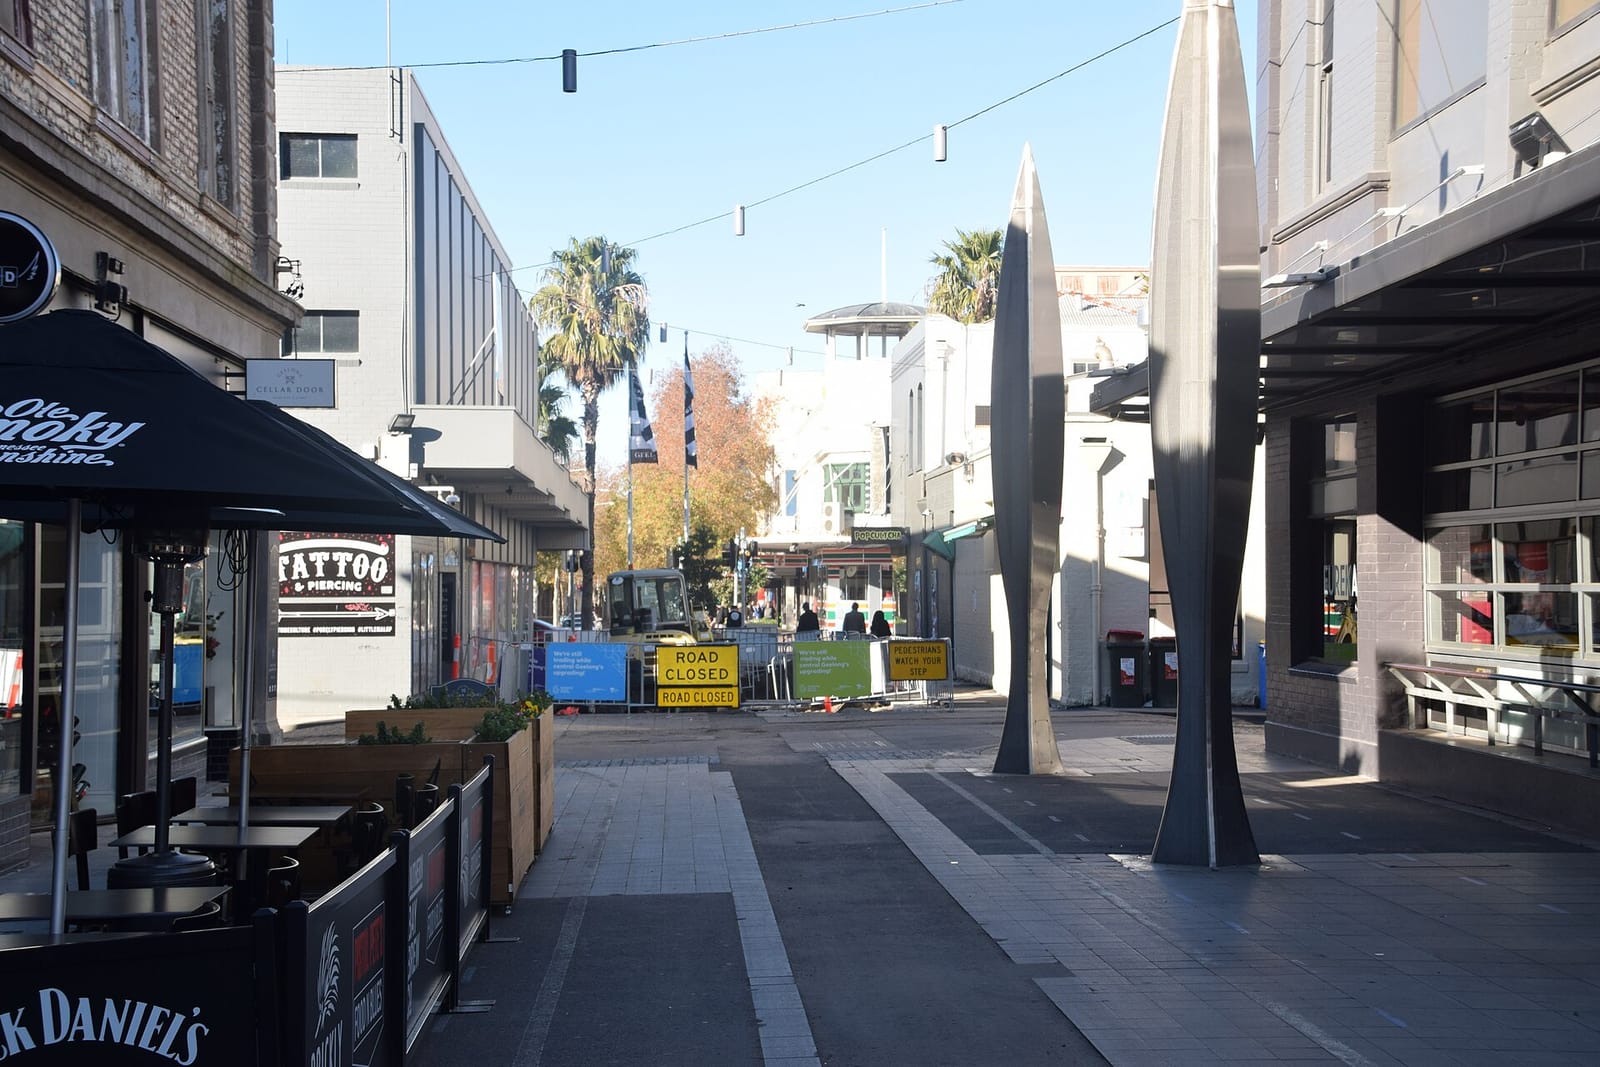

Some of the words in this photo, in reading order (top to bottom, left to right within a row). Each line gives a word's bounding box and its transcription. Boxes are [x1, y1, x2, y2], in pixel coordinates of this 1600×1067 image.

[4, 398, 79, 420] Ole
[855, 530, 902, 541] POPCULTCHA
[279, 551, 388, 583] TATTOO
[295, 582, 305, 592] &
[307, 580, 362, 592] PIERCING
[894, 646, 941, 654] PEDESTRIANS
[676, 652, 719, 663] ROAD
[895, 656, 919, 665] WATCH
[922, 656, 941, 665] YOUR
[665, 668, 729, 680] CLOSED
[910, 667, 927, 676] STEP
[663, 692, 690, 703] ROAD
[693, 692, 734, 703] CLOSED
[39, 988, 210, 1066] DANIEL'S
